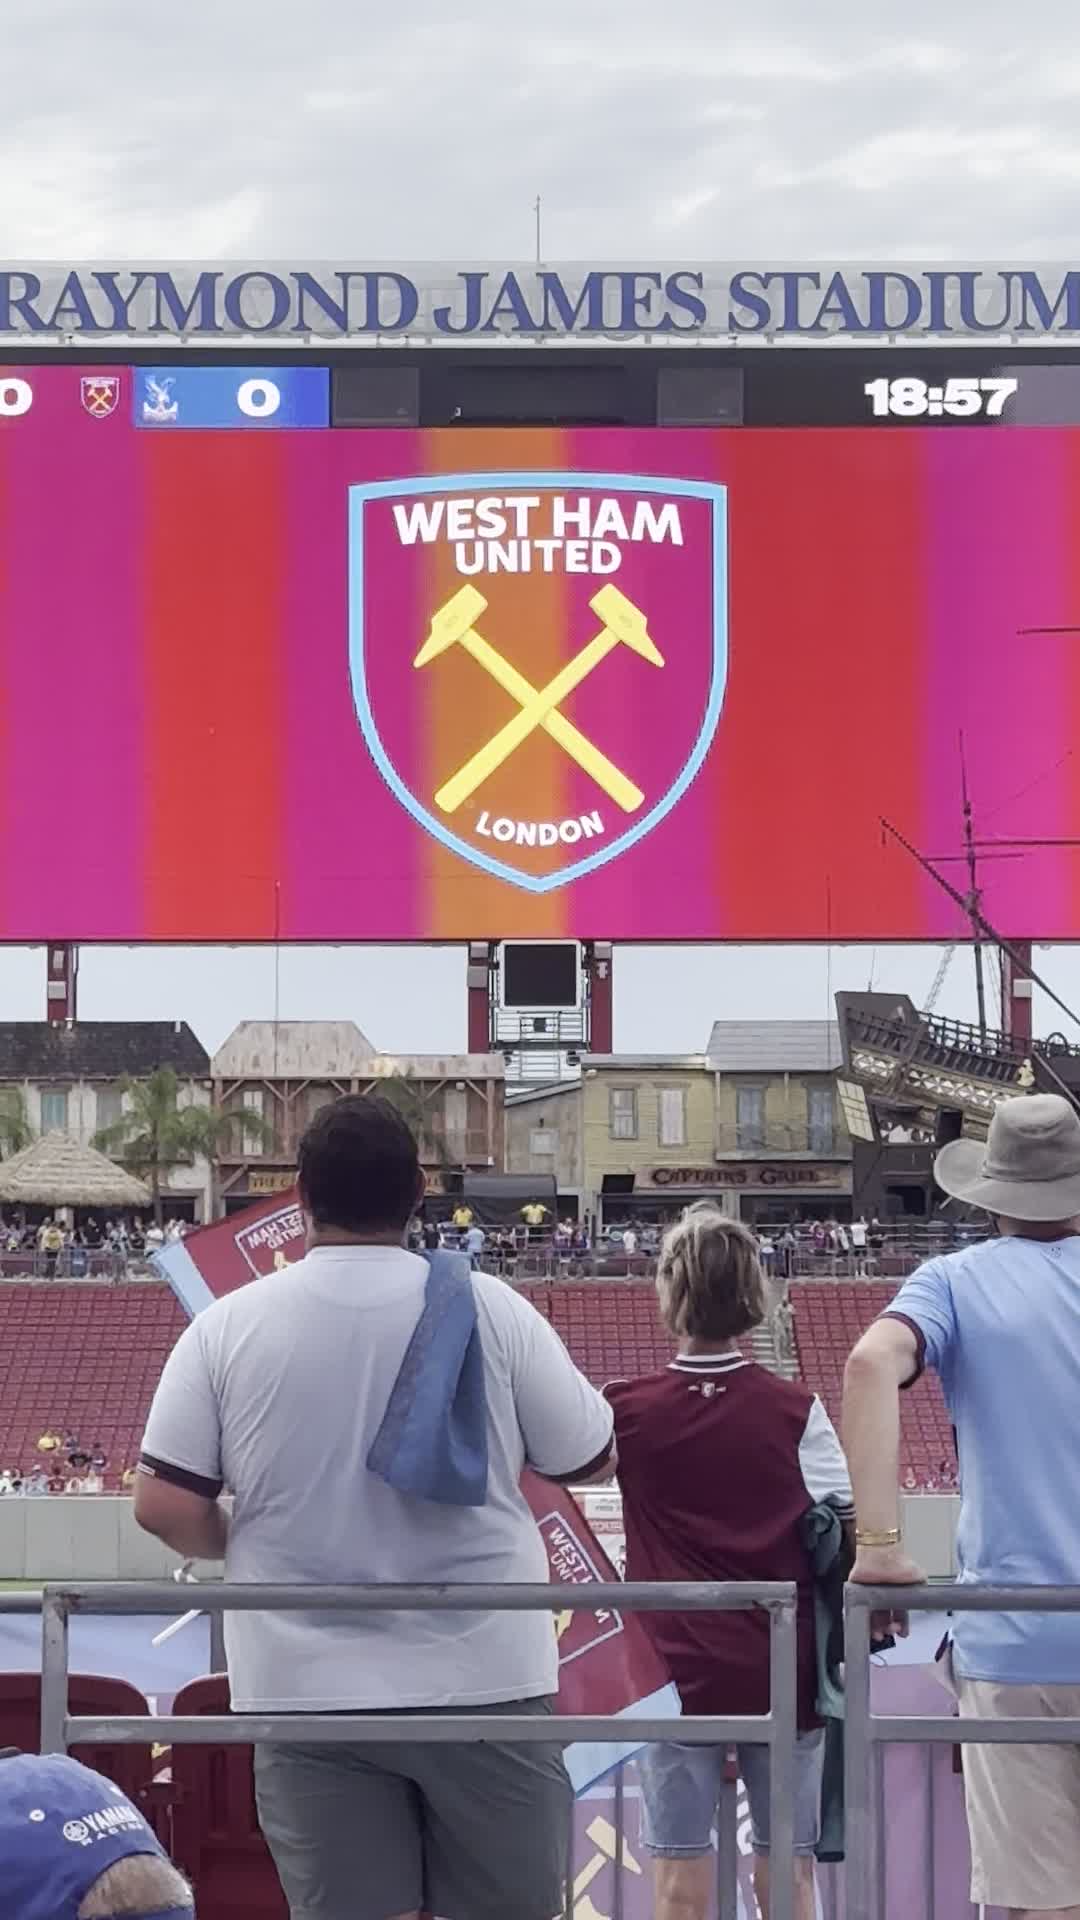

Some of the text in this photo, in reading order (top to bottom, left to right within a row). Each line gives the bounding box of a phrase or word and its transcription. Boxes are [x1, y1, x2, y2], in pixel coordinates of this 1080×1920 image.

[0, 271, 1080, 333] RAYMOND JAMES STADIUM
[864, 377, 1018, 416] 18:57
[393, 496, 684, 546] WEST HAM
[455, 540, 622, 575] UNITED
[475, 810, 605, 846] LONDON
[549, 1527, 589, 1573] WEST
